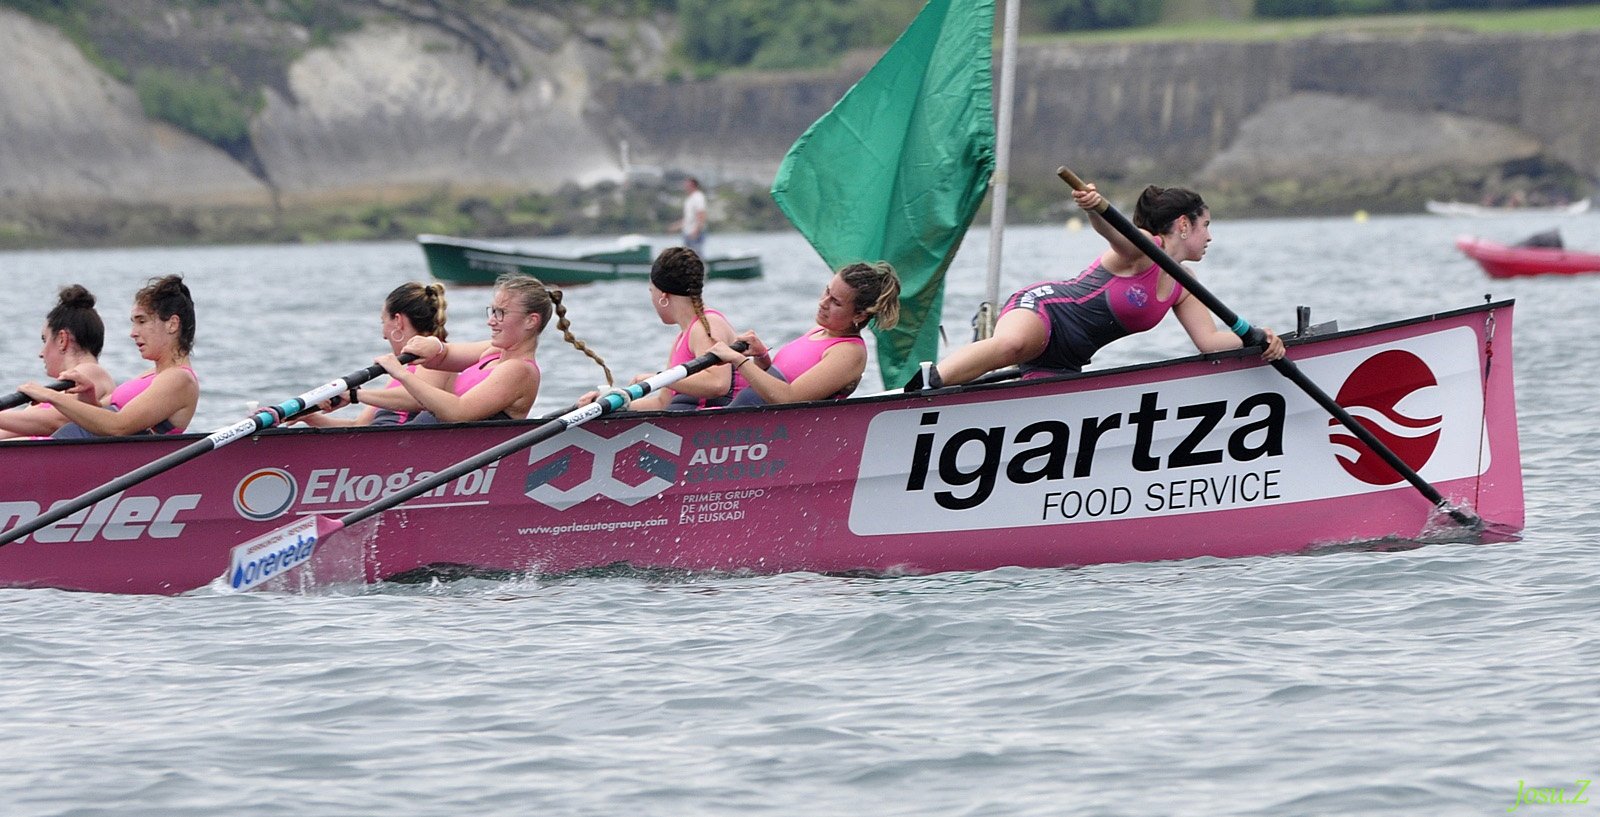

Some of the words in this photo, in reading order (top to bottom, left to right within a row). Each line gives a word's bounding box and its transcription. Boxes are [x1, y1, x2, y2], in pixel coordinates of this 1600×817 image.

[692, 423, 789, 448] GORLA
[688, 443, 768, 466] AUTO
[906, 392, 1287, 511] igartza
[686, 459, 785, 483] GROUP
[681, 503, 698, 514] DE
[698, 500, 740, 513] MOTOR
[682, 492, 721, 504] PRIMER
[724, 488, 764, 501] GRUPO
[1042, 485, 1132, 521] FOOD
[1144, 470, 1281, 512] SERVICE
[517, 518, 668, 536] www.gorlaautogroup.com
[679, 514, 695, 525] EN
[698, 510, 746, 523] EUSKADI
[243, 534, 316, 585] orereta
